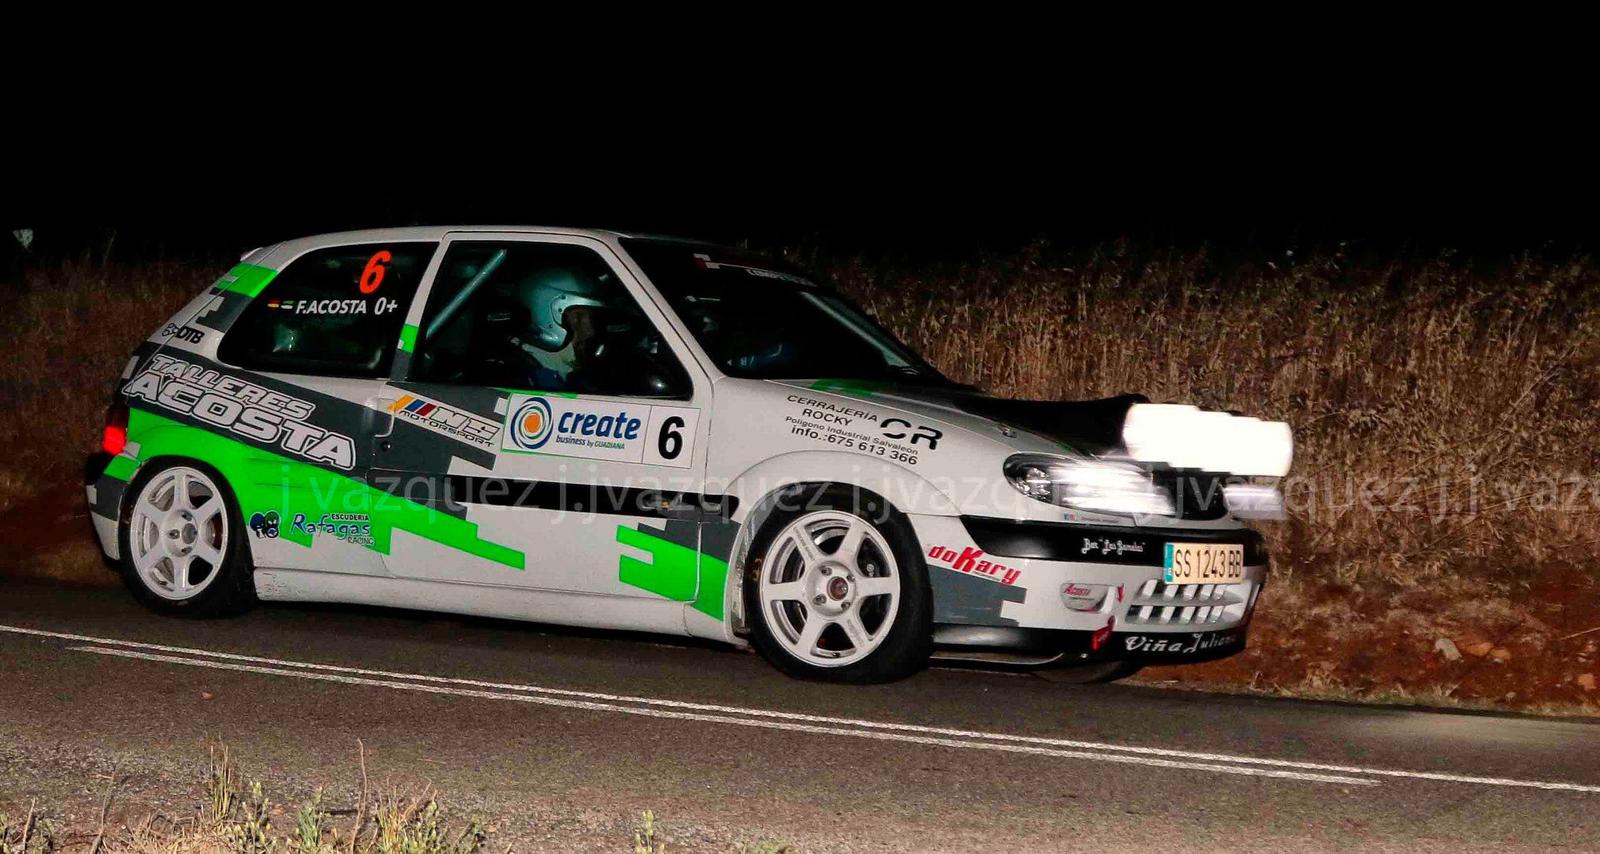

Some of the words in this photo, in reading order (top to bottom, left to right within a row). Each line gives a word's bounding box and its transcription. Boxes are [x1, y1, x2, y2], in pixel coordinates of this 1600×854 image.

[360, 250, 391, 294] 6
[296, 299, 367, 315] F.ACOSTA
[176, 326, 205, 344] DTB
[149, 354, 315, 421] TALLERES
[121, 370, 356, 470] ACOSTA
[557, 411, 641, 440] create
[802, 408, 853, 426] ROCKY
[399, 410, 495, 448] MOTORSPORT
[658, 416, 685, 460] 6
[827, 426, 871, 442] Industrial
[556, 435, 586, 446] business
[586, 441, 594, 449] by
[858, 442, 886, 456] 613
[889, 451, 918, 465] 366
[331, 513, 369, 521] ESCUDERIA
[347, 537, 374, 545] RACING
[928, 545, 1022, 586] doKary
[1174, 548, 1192, 578] SS
[1196, 549, 1226, 578] 1243
[1227, 550, 1241, 578] BB
[1125, 635, 1183, 653] Viña
